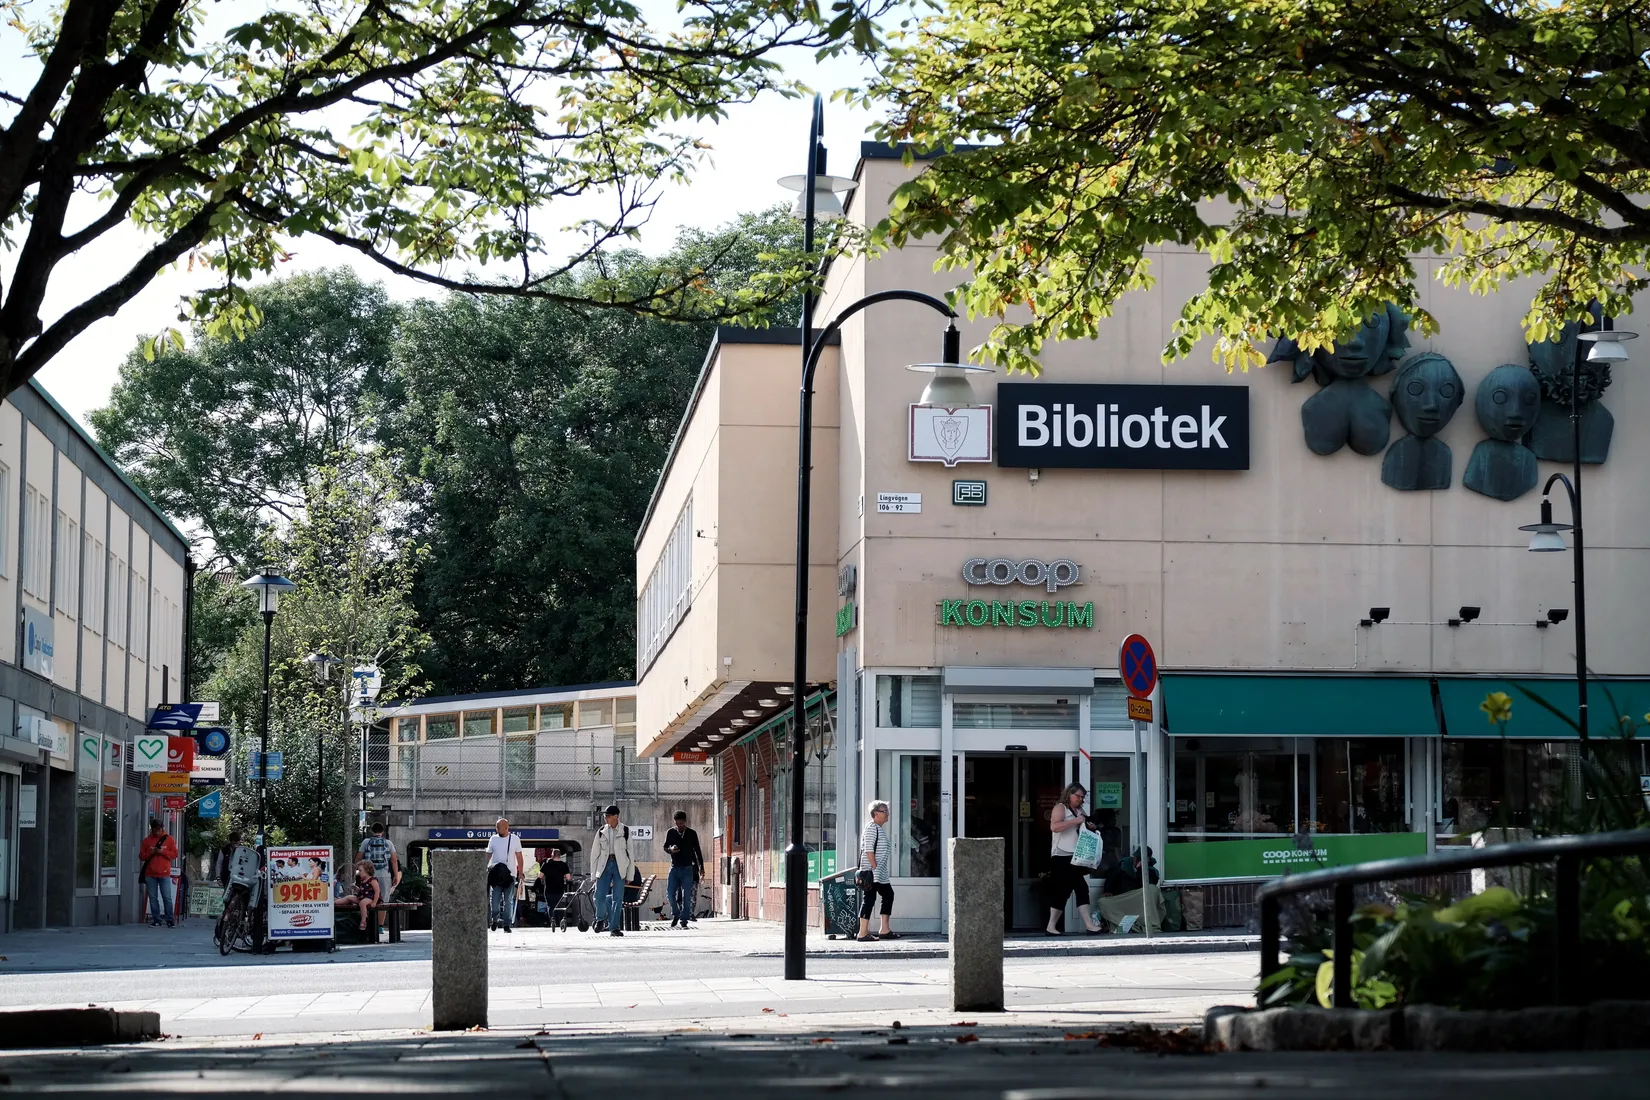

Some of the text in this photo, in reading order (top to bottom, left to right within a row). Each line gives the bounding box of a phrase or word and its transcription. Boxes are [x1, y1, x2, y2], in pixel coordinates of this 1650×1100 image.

[1018, 402, 1229, 449] Bibliotek
[878, 503, 890, 512] 106
[895, 503, 904, 512] 92
[962, 557, 1081, 593] coop
[941, 599, 1094, 629] KONSUM
[680, 752, 700, 761] Uttag
[1263, 850, 1291, 859] coop
[280, 883, 321, 902] 99kr
